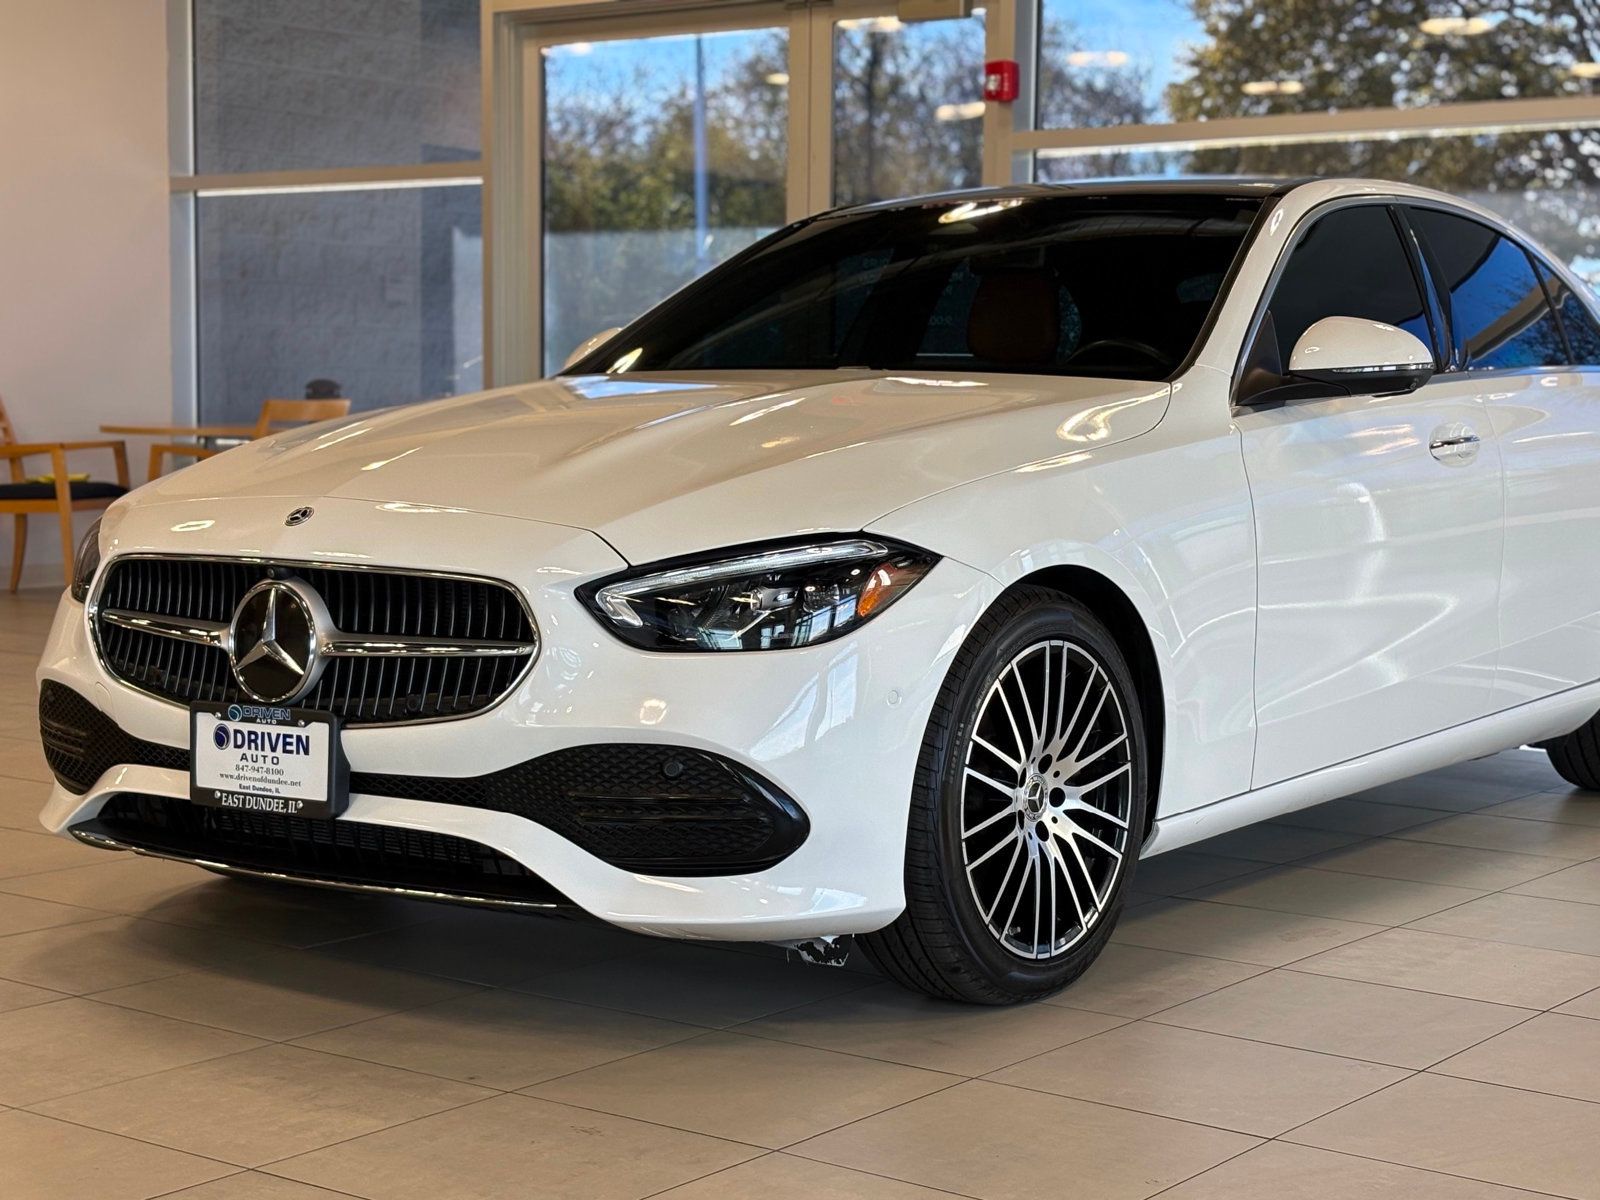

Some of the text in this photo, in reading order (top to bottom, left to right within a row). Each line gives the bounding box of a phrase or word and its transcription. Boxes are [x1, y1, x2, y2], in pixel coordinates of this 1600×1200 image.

[243, 705, 291, 720] DRIVEN
[233, 729, 310, 756] DRIVEN
[240, 753, 280, 766] AUTO
[235, 764, 284, 776] 847-947-8100
[219, 772, 302, 787] www.drivenofdundee.net
[239, 783, 251, 791] East
[221, 792, 298, 814] EAST DUNDEE, IL
